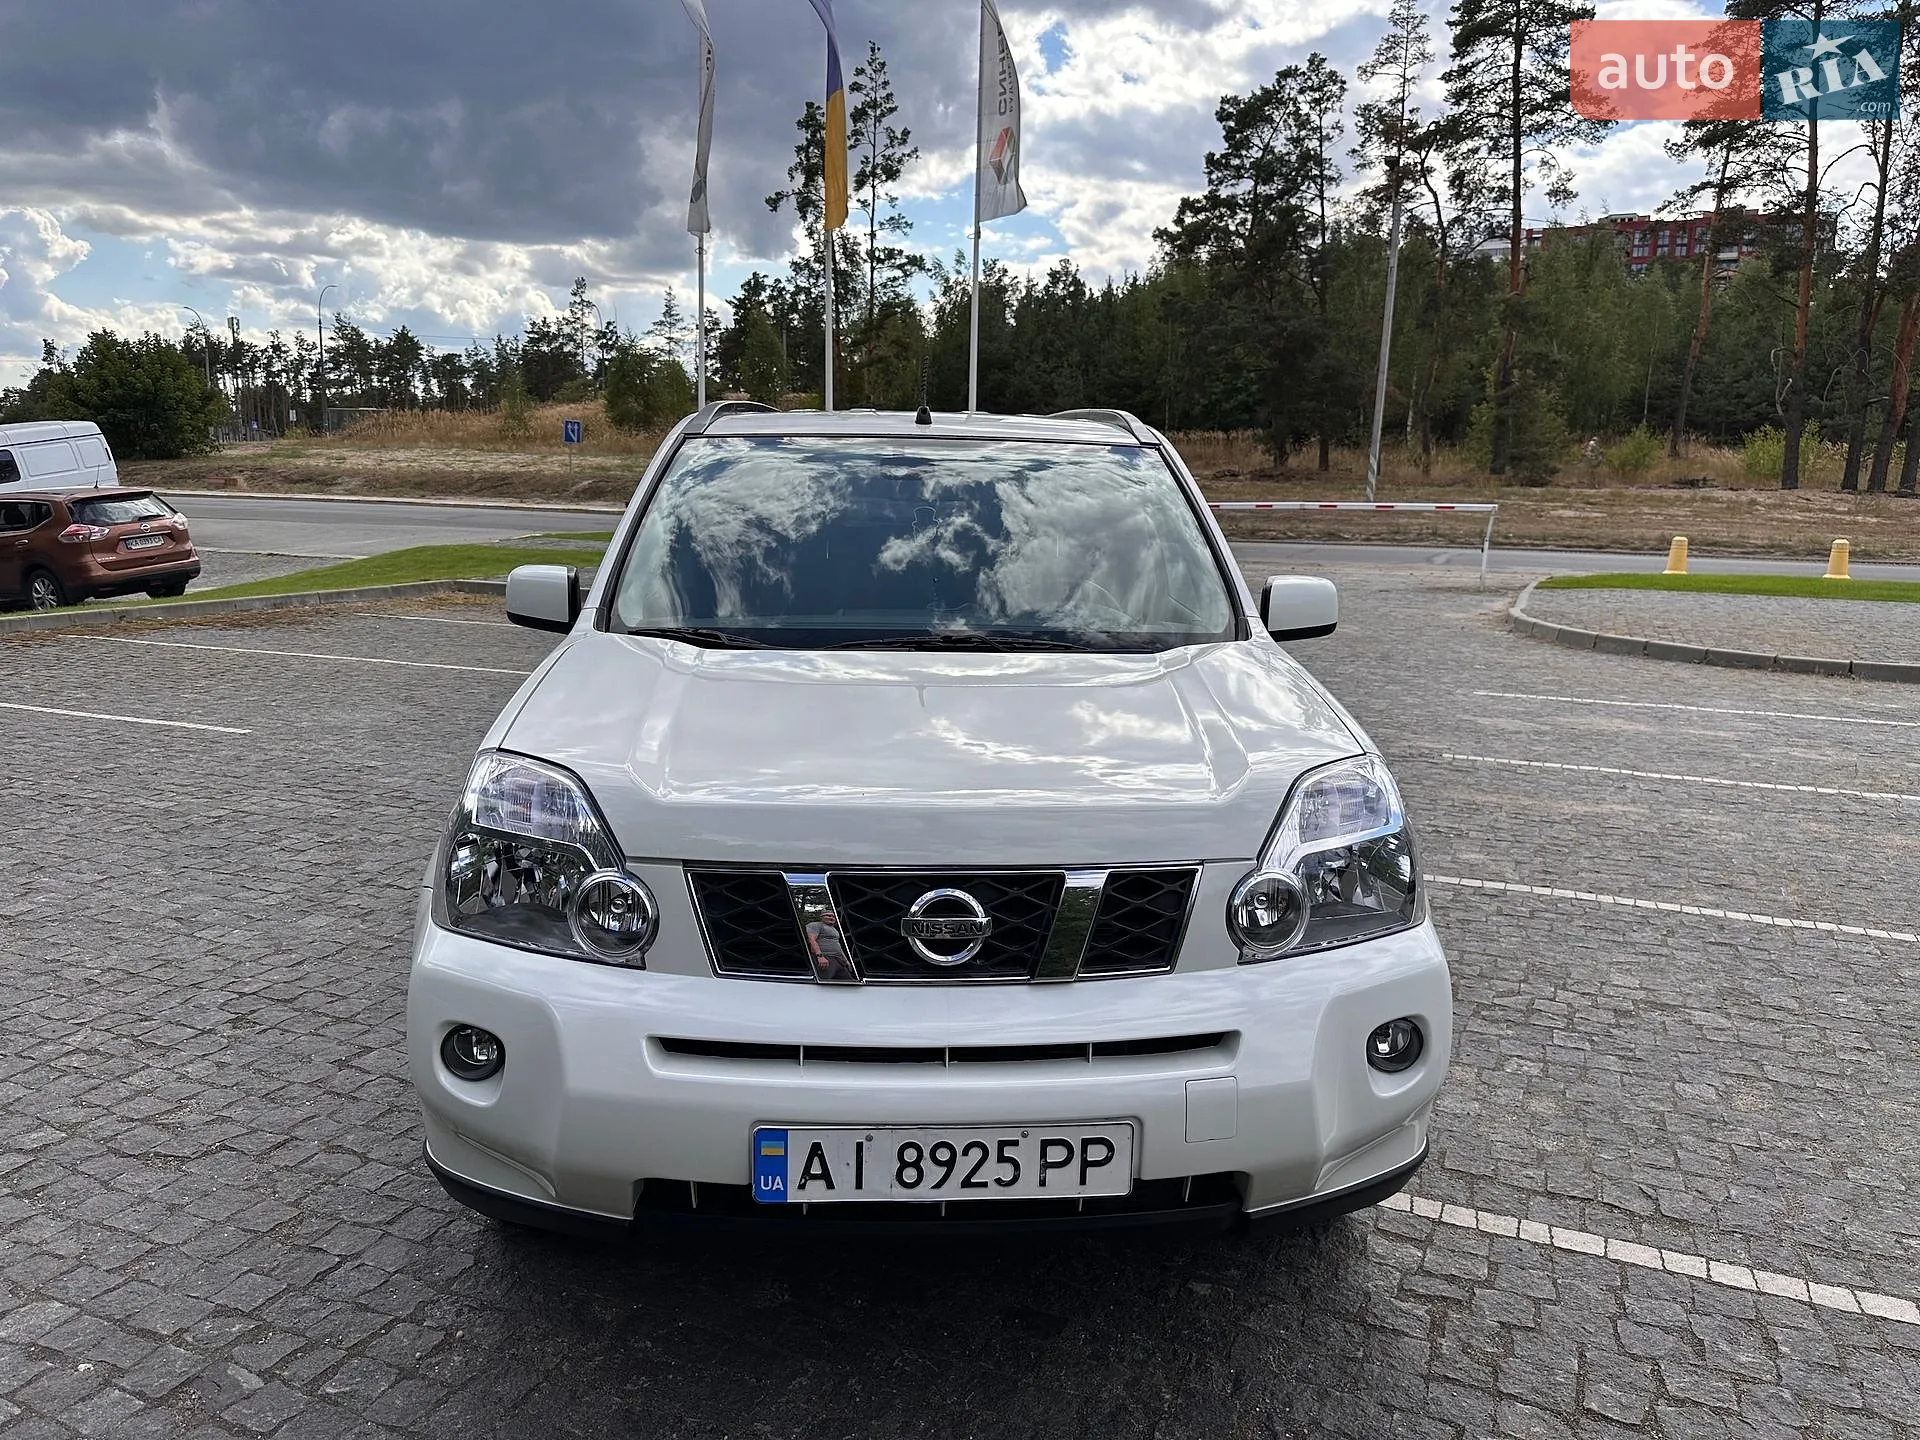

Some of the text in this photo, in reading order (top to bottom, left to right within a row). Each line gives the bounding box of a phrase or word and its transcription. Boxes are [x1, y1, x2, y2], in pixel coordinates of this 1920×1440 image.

[912, 922, 983, 935] NISSAN
[895, 1139, 1021, 1189] 8925
[1038, 1137, 1116, 1188] PP
[760, 1175, 784, 1191] UA
